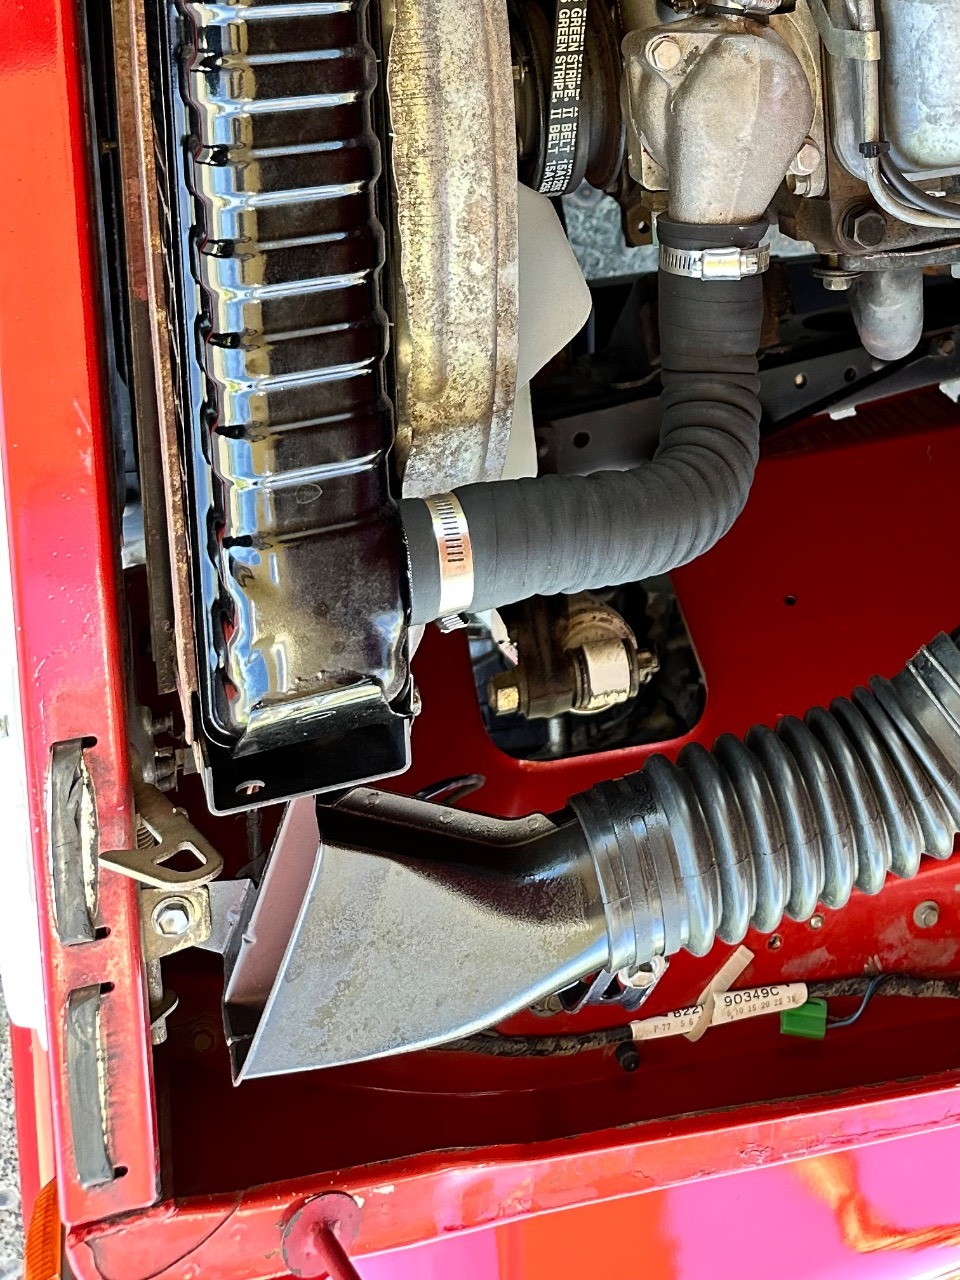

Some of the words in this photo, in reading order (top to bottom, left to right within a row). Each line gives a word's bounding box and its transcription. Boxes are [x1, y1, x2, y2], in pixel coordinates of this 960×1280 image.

[555, 8, 570, 53] GREEN
[567, 7, 582, 52] GREEN
[550, 108, 561, 119] II
[562, 107, 573, 119] II
[547, 124, 560, 155] BELT
[558, 122, 572, 153] BELT
[724, 986, 780, 1007] 90349C
[761, 1001, 770, 1010] 20
[653, 1023, 671, 1033] P-77
